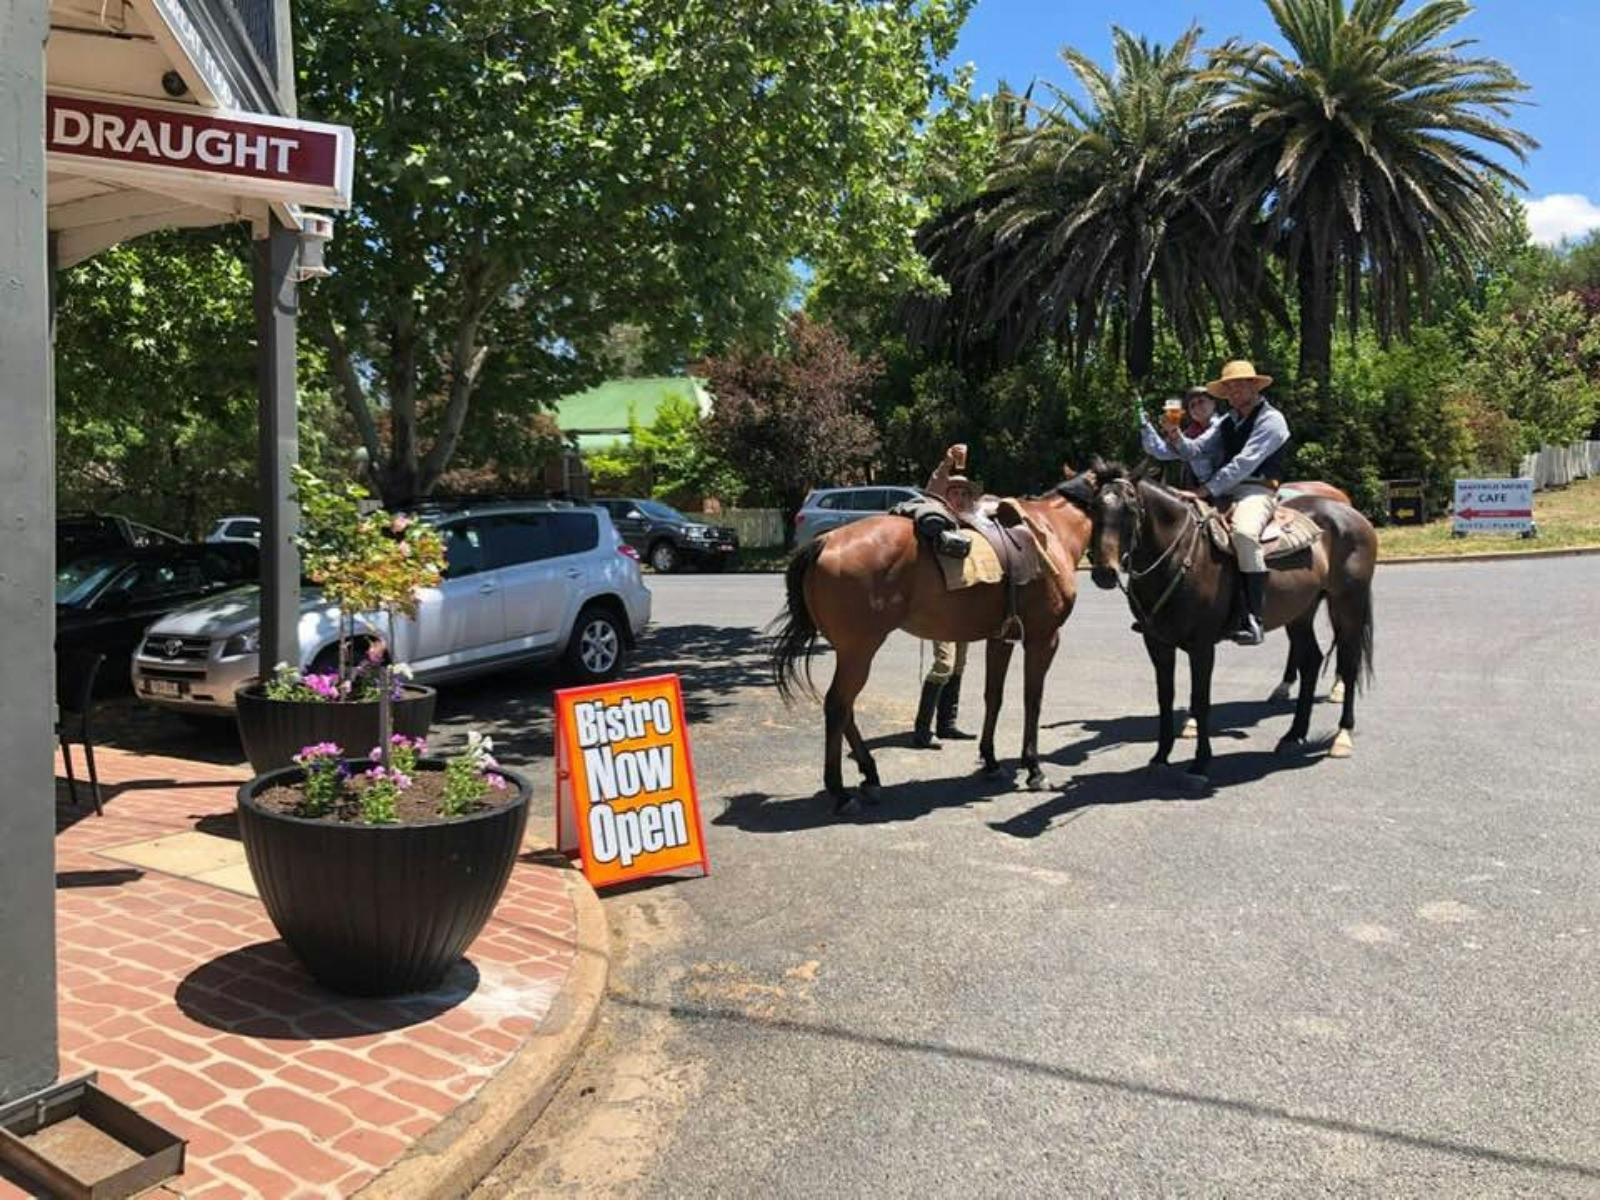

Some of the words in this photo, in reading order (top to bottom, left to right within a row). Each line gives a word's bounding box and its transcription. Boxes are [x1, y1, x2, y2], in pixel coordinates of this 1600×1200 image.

[52, 107, 299, 174] DRAUGHT
[1478, 493, 1507, 503] CAFE
[574, 697, 672, 748] Bistro
[583, 745, 674, 803] Now
[589, 801, 689, 867] Open
